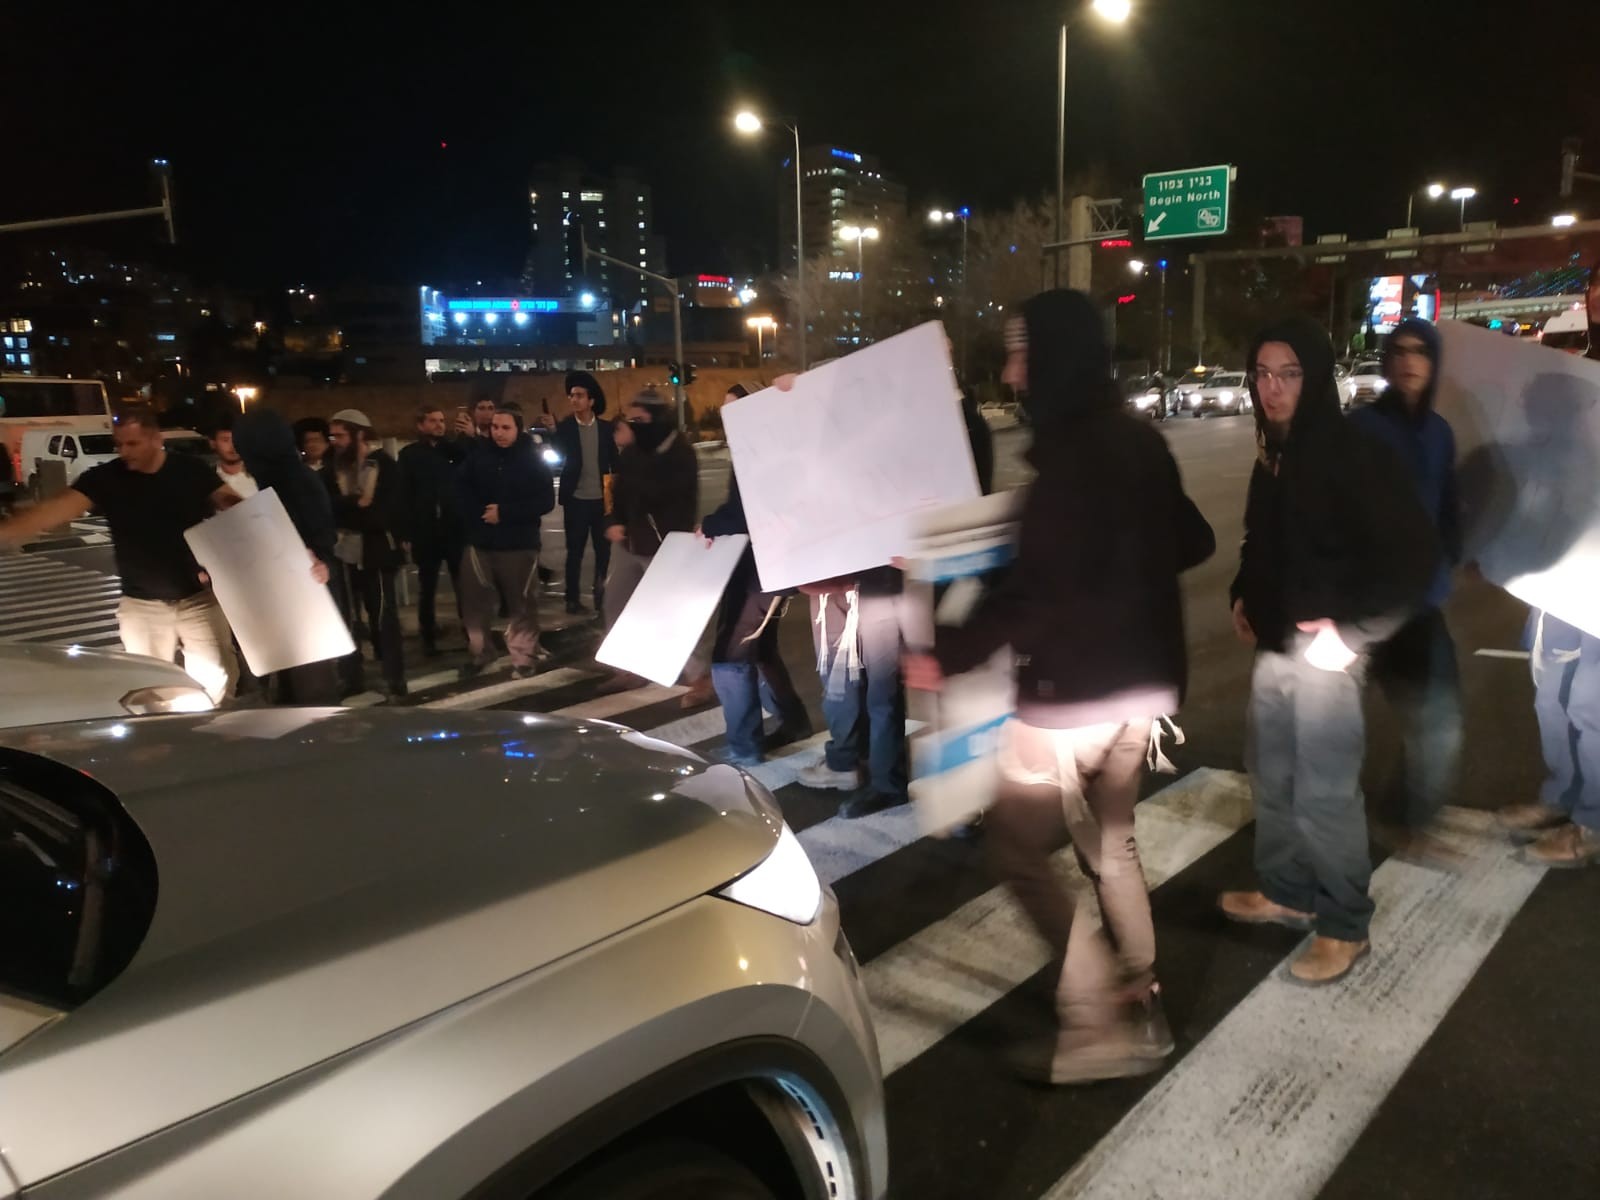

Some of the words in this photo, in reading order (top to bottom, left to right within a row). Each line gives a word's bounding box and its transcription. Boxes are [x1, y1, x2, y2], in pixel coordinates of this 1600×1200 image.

[1158, 178, 1184, 192] צפון
[1189, 176, 1212, 188] בגין
[1149, 194, 1182, 207] Begin
[1187, 189, 1221, 202] North
